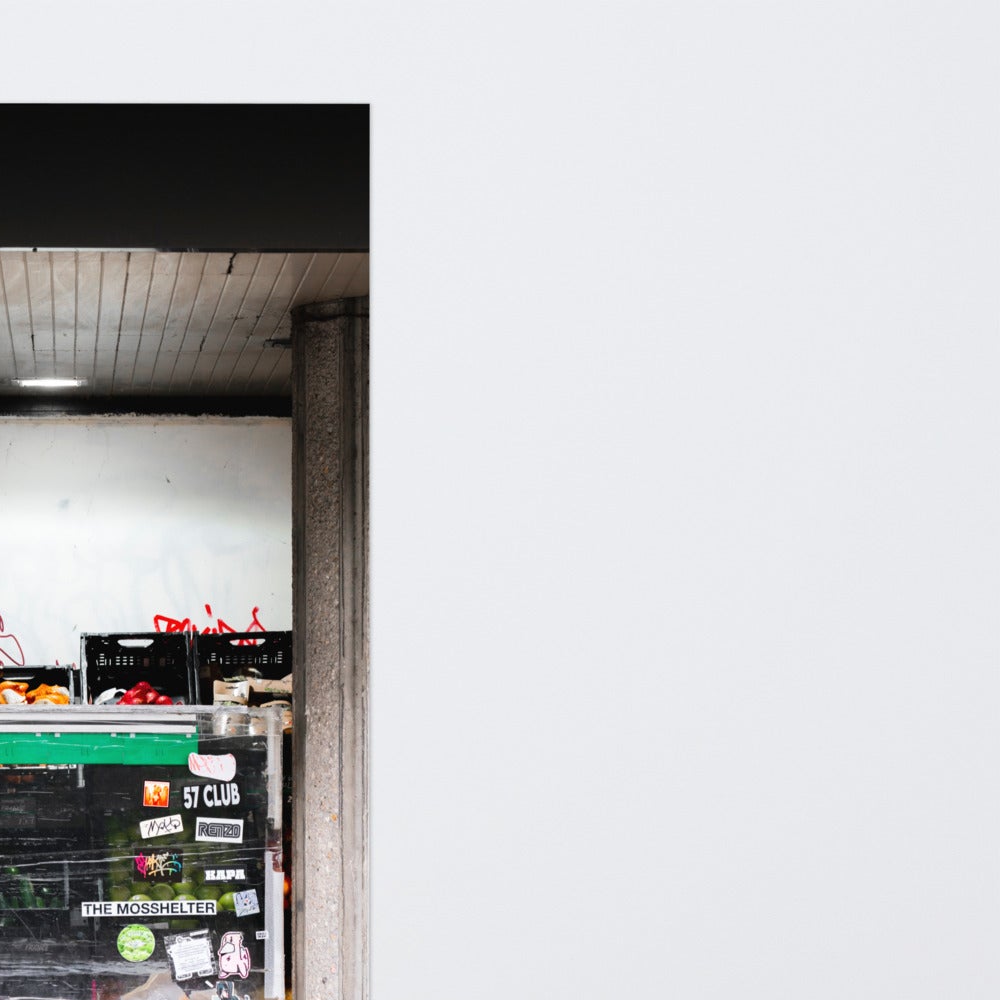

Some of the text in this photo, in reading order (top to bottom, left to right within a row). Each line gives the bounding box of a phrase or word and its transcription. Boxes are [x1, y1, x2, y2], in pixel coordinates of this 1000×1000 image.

[183, 783, 241, 809] 57 CLUB
[204, 869, 246, 880] KAPA
[83, 901, 215, 915] THE MOSSHELTER
